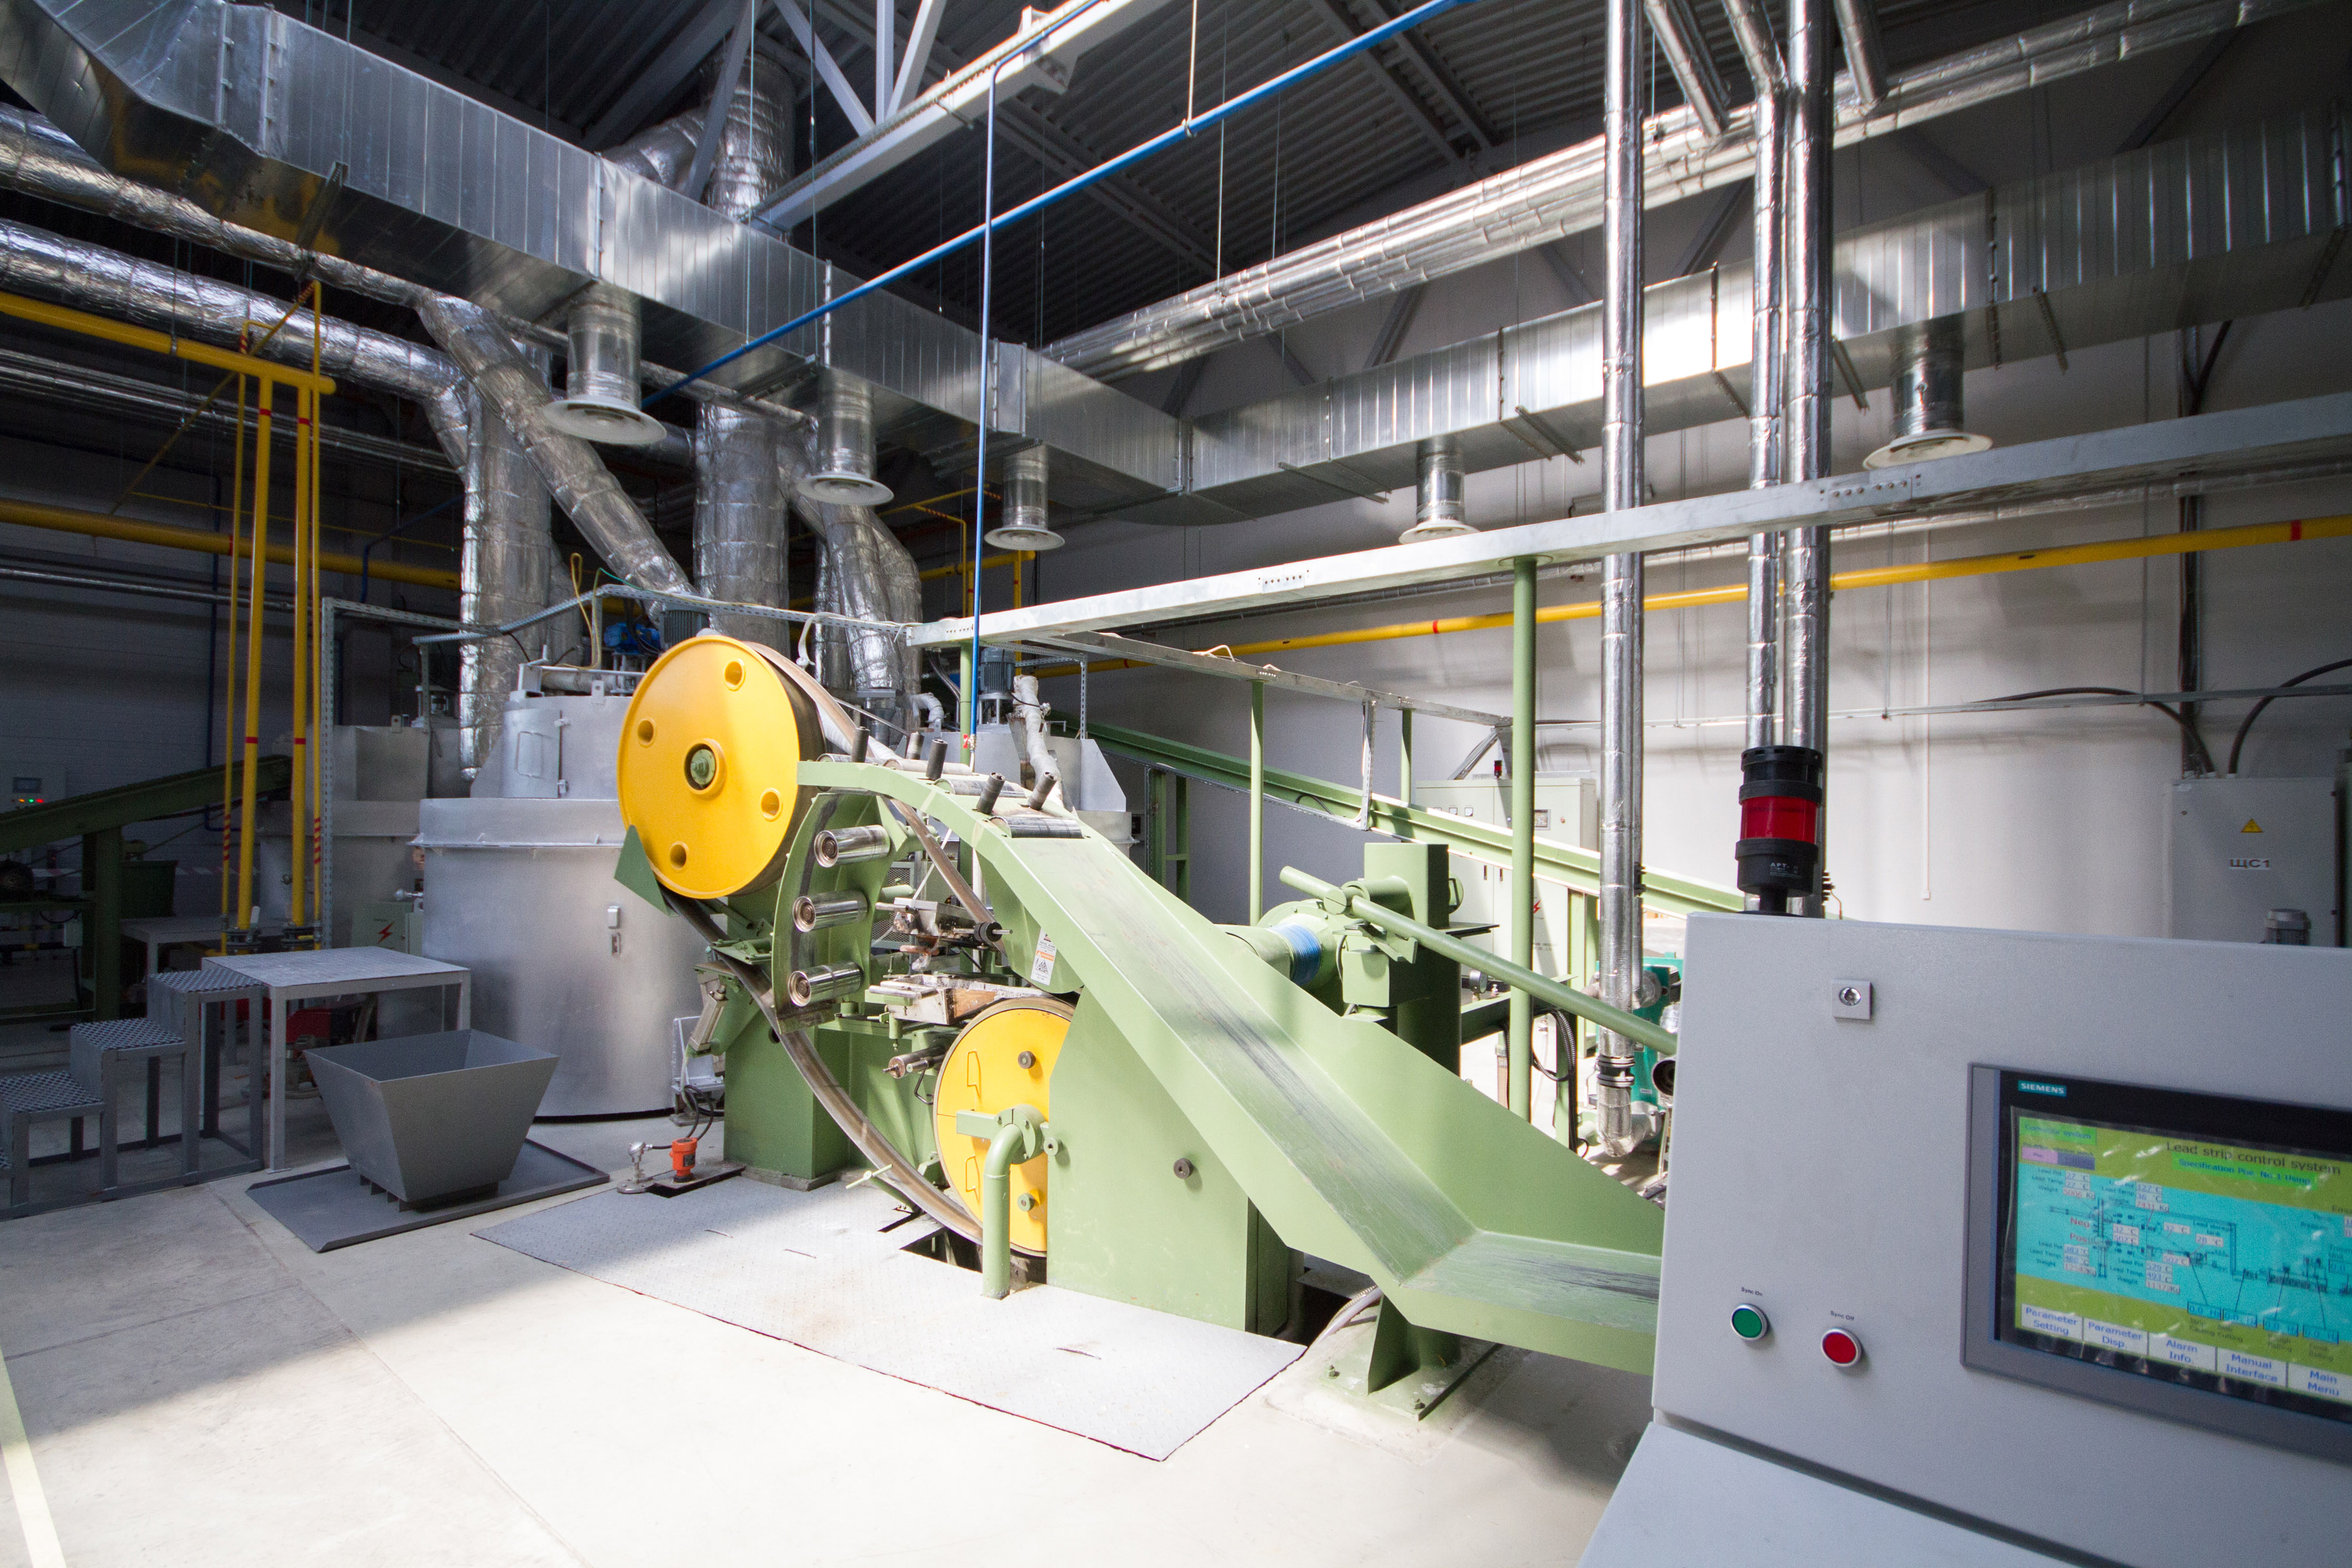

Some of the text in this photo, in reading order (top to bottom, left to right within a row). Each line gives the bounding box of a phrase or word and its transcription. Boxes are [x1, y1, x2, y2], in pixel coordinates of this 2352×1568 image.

[2229, 858, 2270, 870] ЩС1
[2021, 1083, 2065, 1094] SIEMENS
[2166, 1141, 2341, 1175] Lead strip control system
[2179, 1158, 2234, 1173] Specification
[2070, 1217, 2091, 1230] Neg
[2026, 1307, 2078, 1325] Parameter
[2033, 1319, 2070, 1336] Setting
[2088, 1320, 2143, 1341] Parameter
[2102, 1335, 2127, 1350] Disp.
[2166, 1339, 2198, 1352] Alarm
[2231, 1353, 2272, 1369] Manual
[2226, 1364, 2278, 1383] Interface
[2310, 1369, 2338, 1384] Main
[2308, 1381, 2340, 1397] Menu
